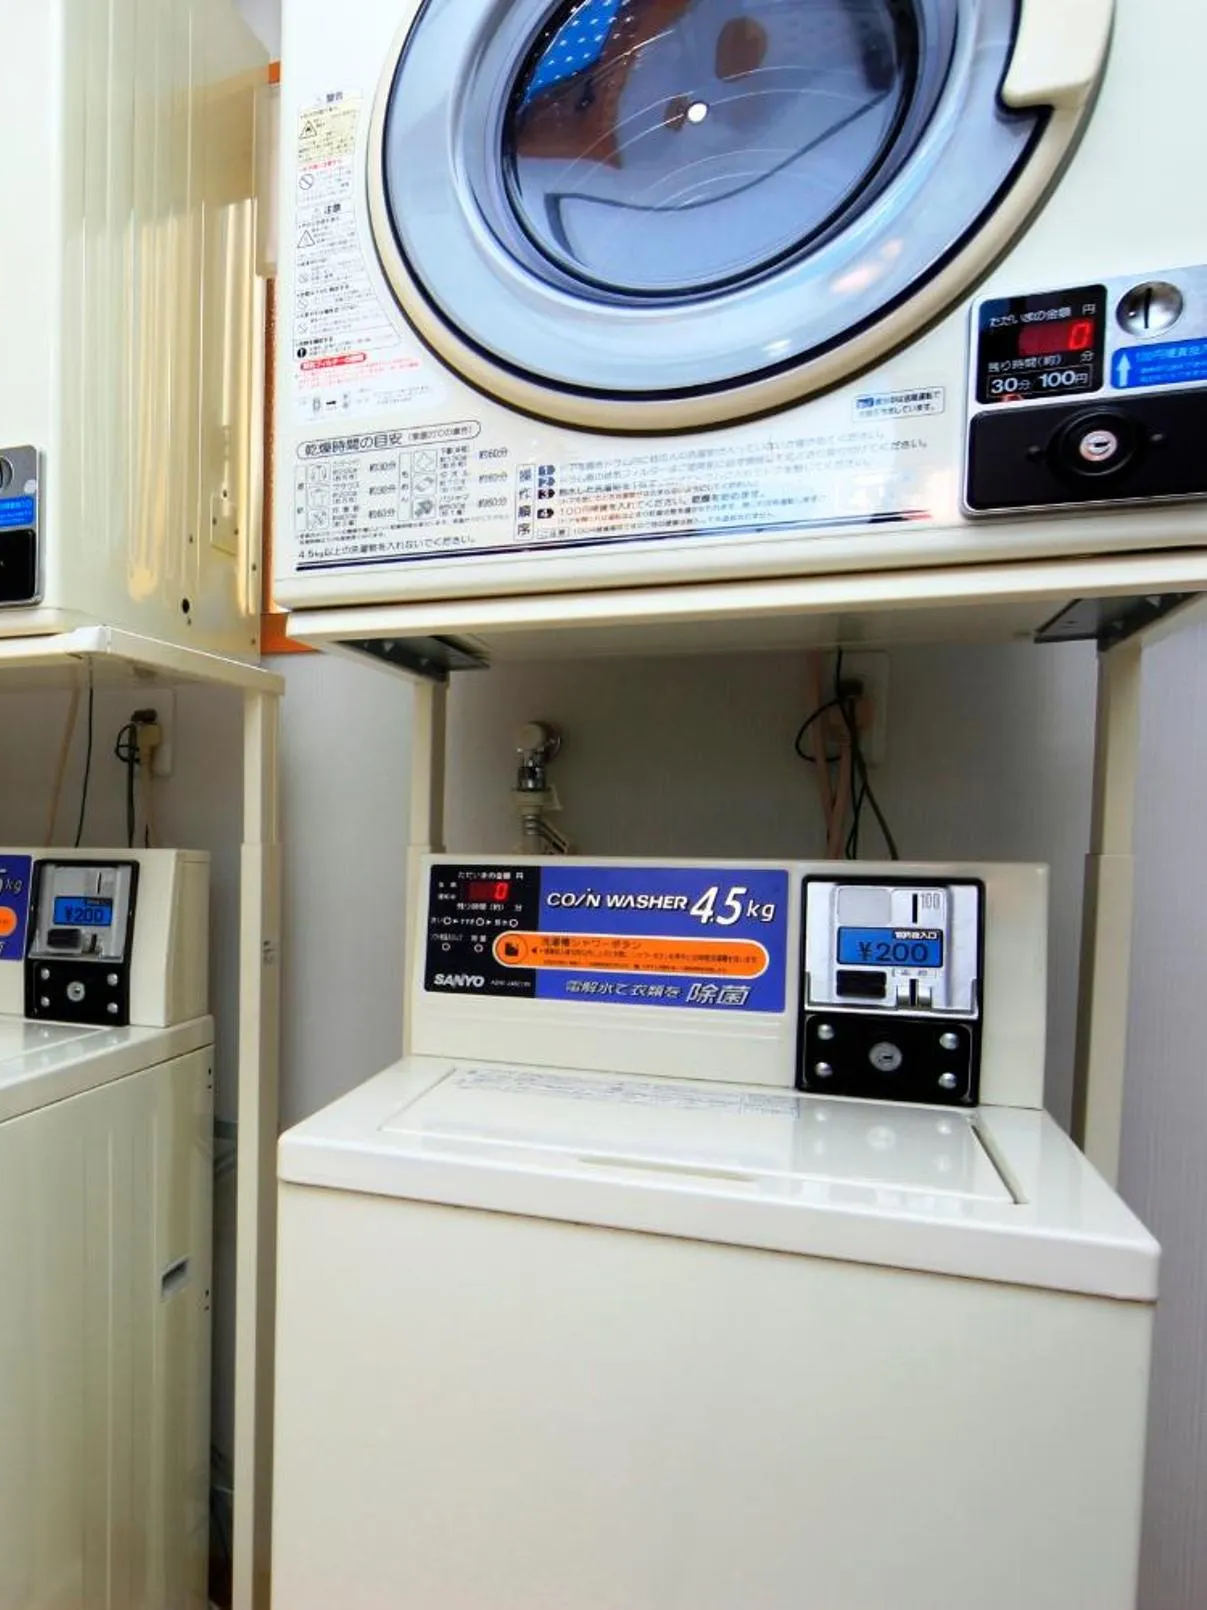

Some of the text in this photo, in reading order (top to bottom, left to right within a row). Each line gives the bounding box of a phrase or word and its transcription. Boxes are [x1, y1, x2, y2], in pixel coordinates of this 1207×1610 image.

[1068, 320, 1091, 350] 0
[606, 893, 689, 911] WASHER
[858, 940, 929, 962] ¥200
[433, 972, 486, 989] SANYO
[685, 981, 753, 1007] 除菌
